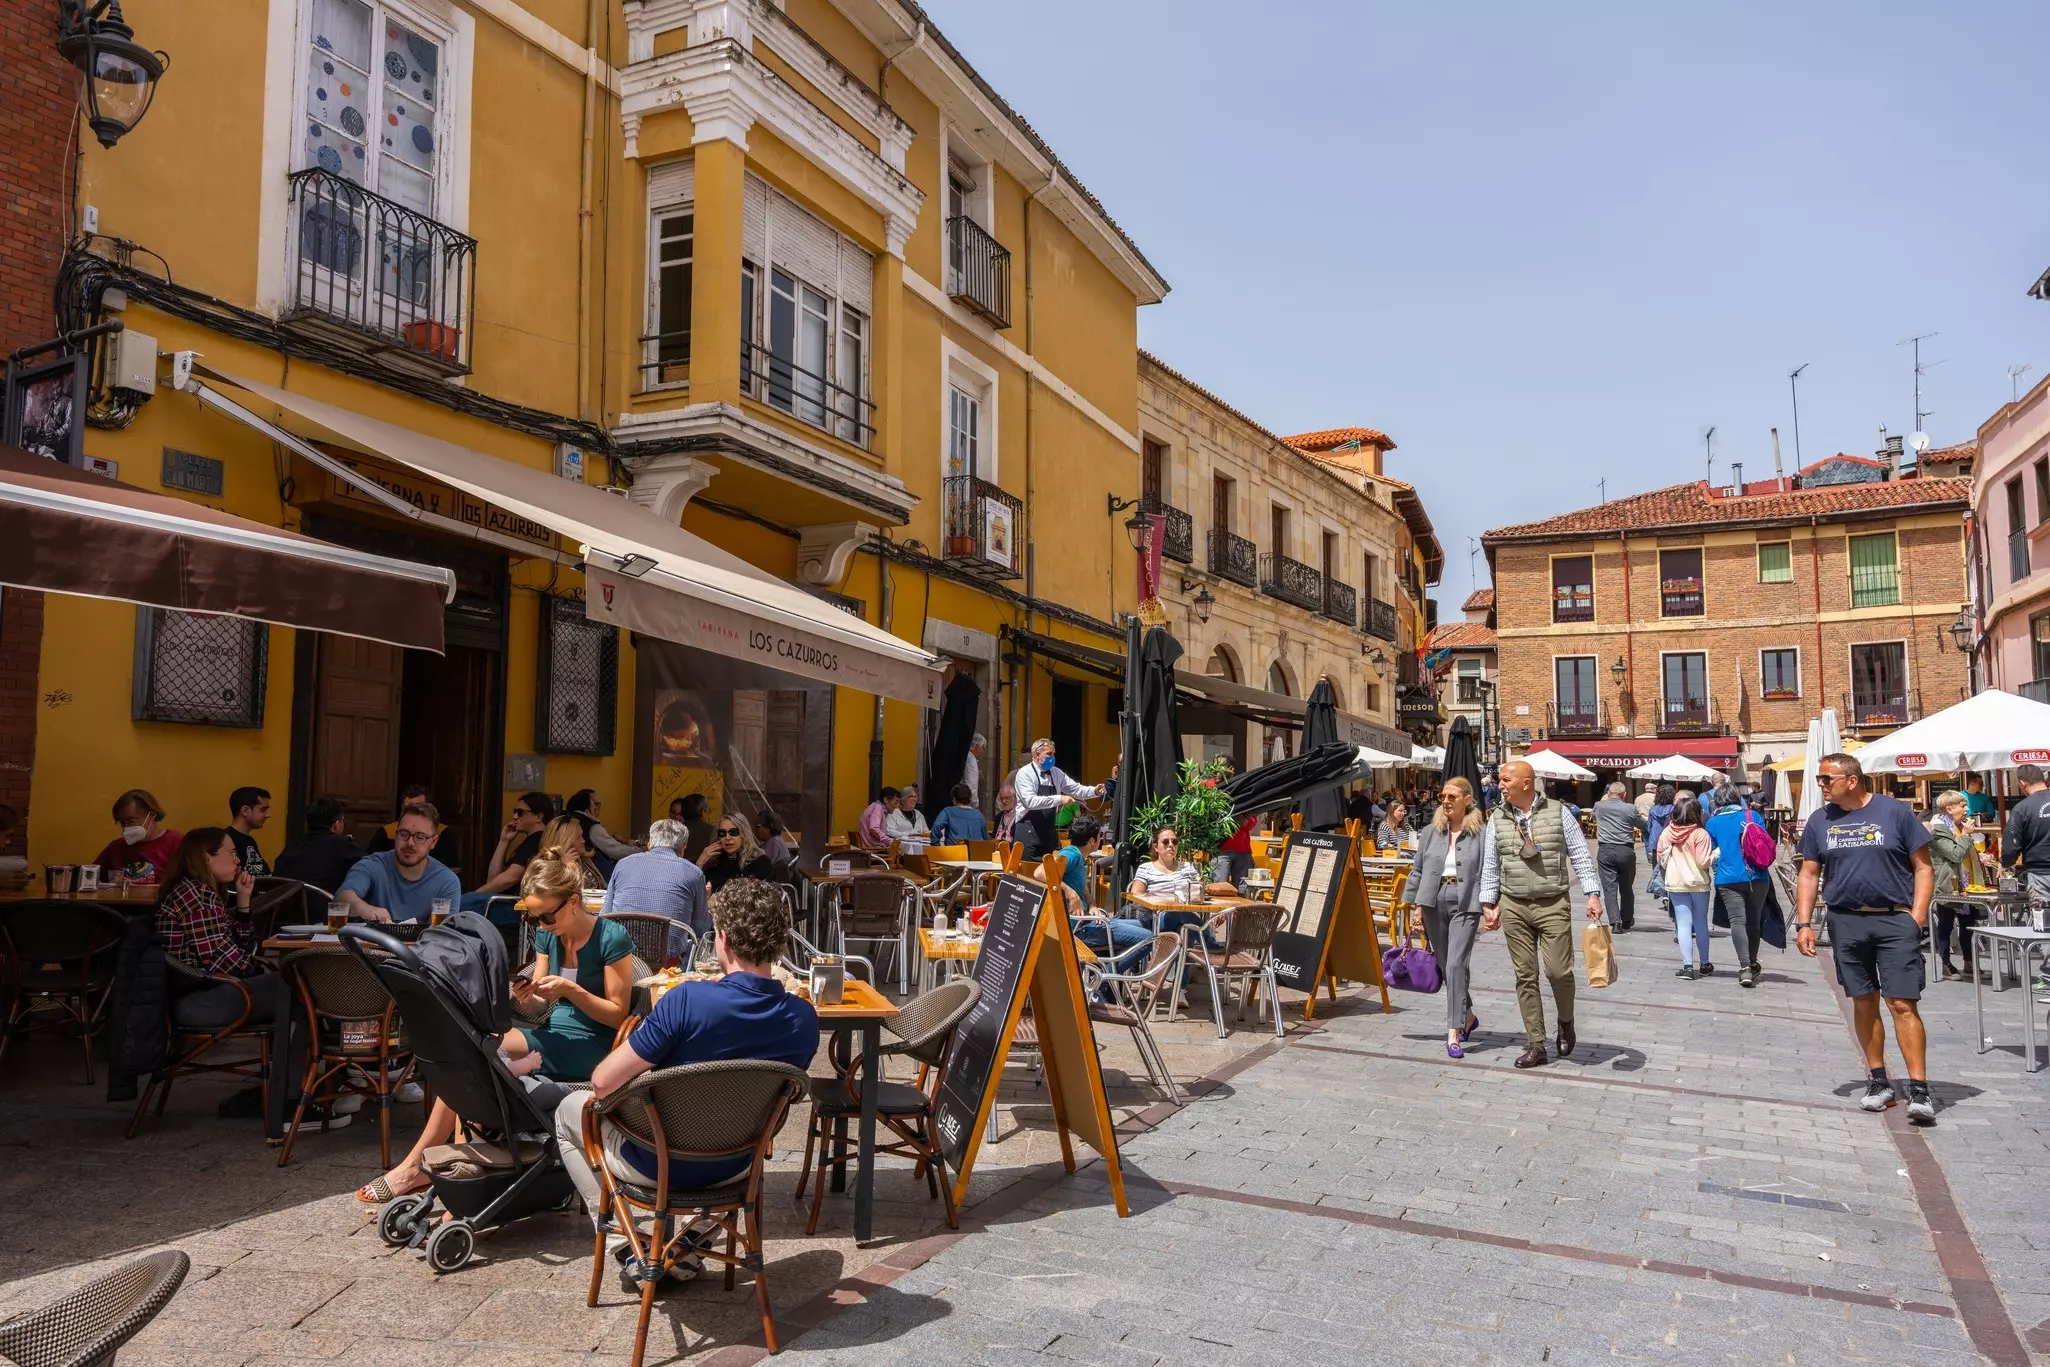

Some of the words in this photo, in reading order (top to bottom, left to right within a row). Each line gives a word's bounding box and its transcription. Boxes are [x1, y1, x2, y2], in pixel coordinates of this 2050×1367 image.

[165, 468, 185, 486] SAN
[697, 620, 739, 640] TABIERNA
[749, 629, 773, 653] LOS
[777, 638, 838, 671] CAZURROS
[963, 635, 970, 646] 10
[1586, 758, 1628, 766] PECADO
